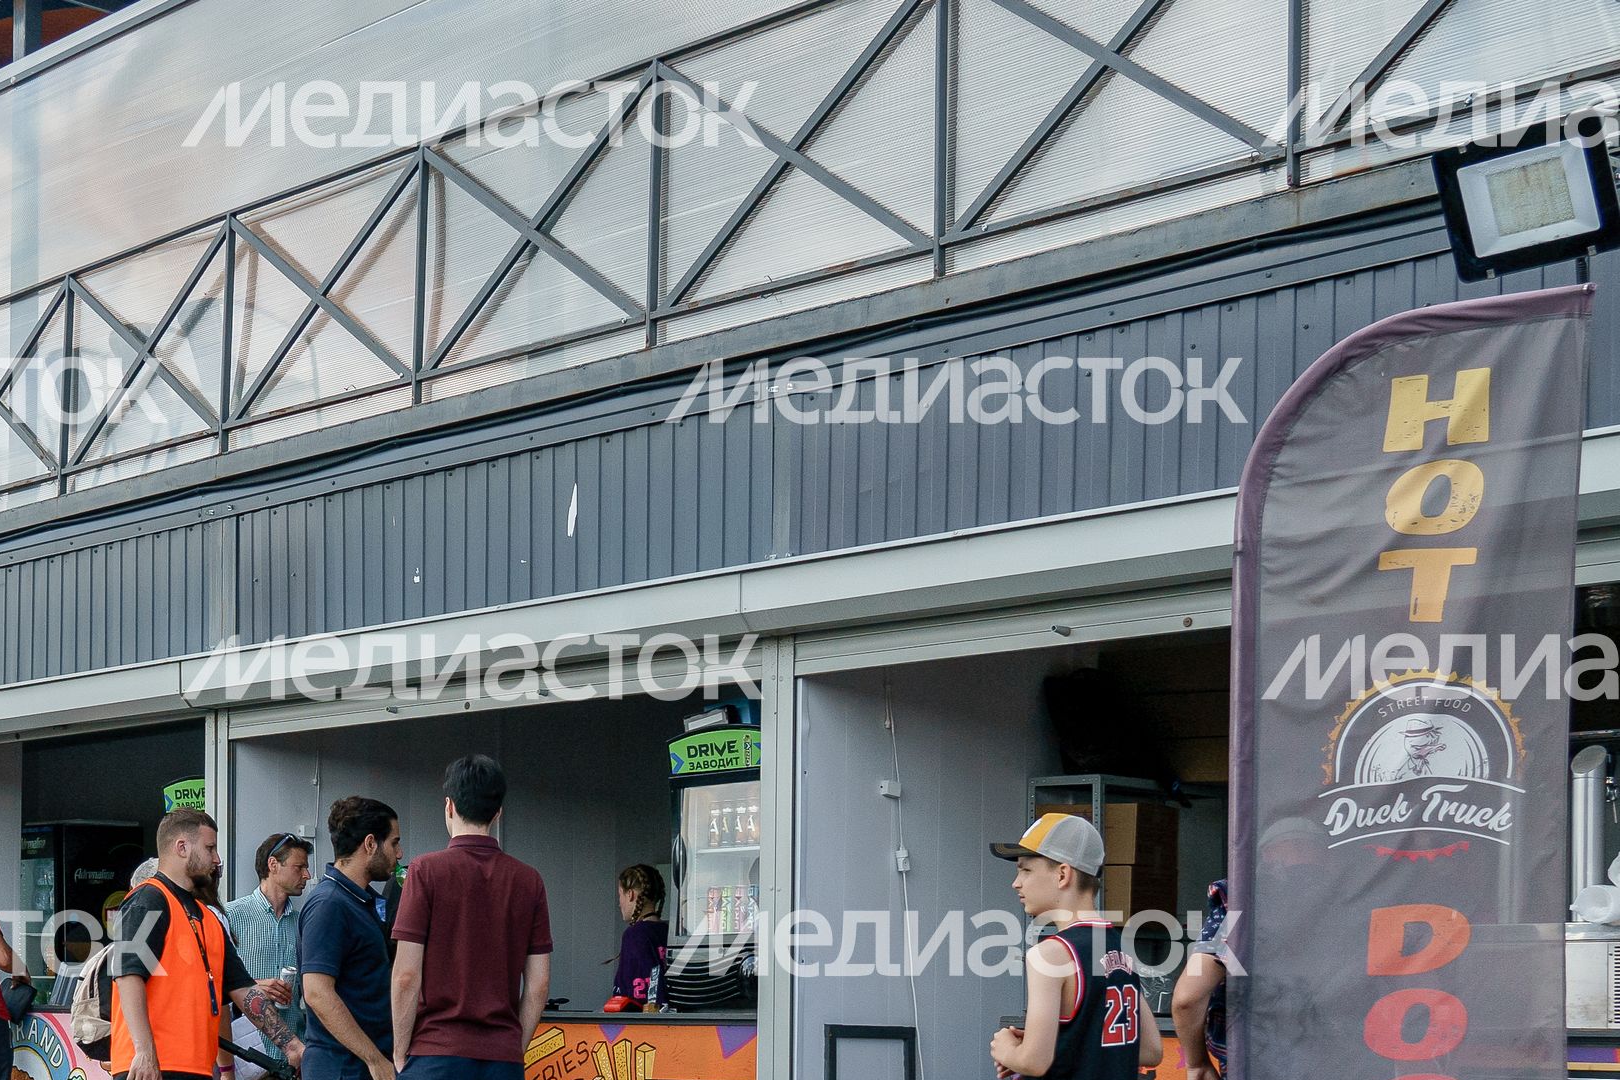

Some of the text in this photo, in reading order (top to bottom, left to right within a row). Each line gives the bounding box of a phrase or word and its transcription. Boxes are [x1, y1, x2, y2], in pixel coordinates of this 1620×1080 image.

[1378, 367, 1491, 623] HOT
[1377, 696, 1472, 718] STREET FOOD
[686, 739, 739, 759] DRIVE
[688, 756, 741, 771] ЗАВОДИТ
[1323, 784, 1513, 836] Duck Truck
[1101, 984, 1138, 1047] 23
[10, 1018, 64, 1068] RAND
